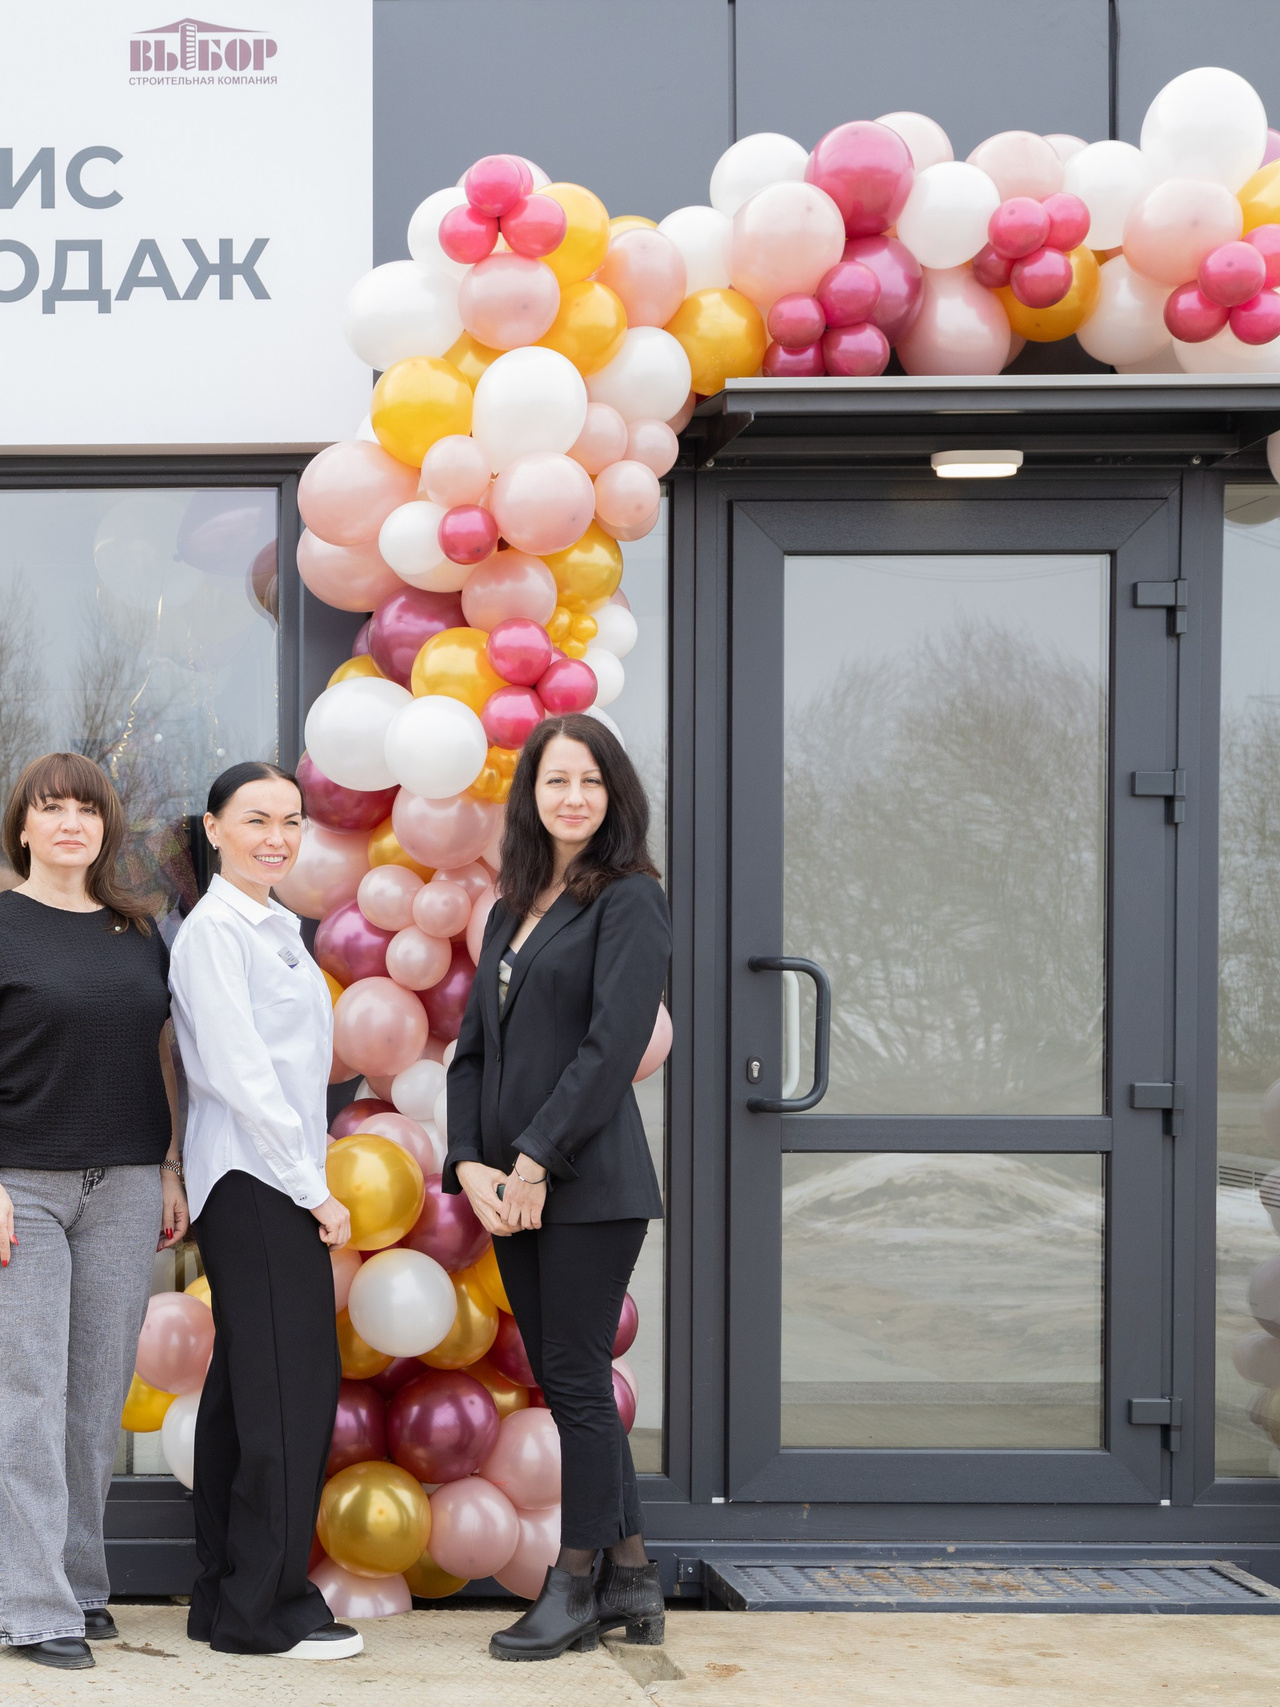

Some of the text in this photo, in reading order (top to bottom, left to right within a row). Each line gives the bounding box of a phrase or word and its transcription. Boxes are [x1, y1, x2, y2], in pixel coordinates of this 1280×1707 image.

[129, 38, 278, 72] ВЫБОР
[128, 75, 278, 86] СТРОИТЕЛЬНАЯ КОМПАНИЯ
